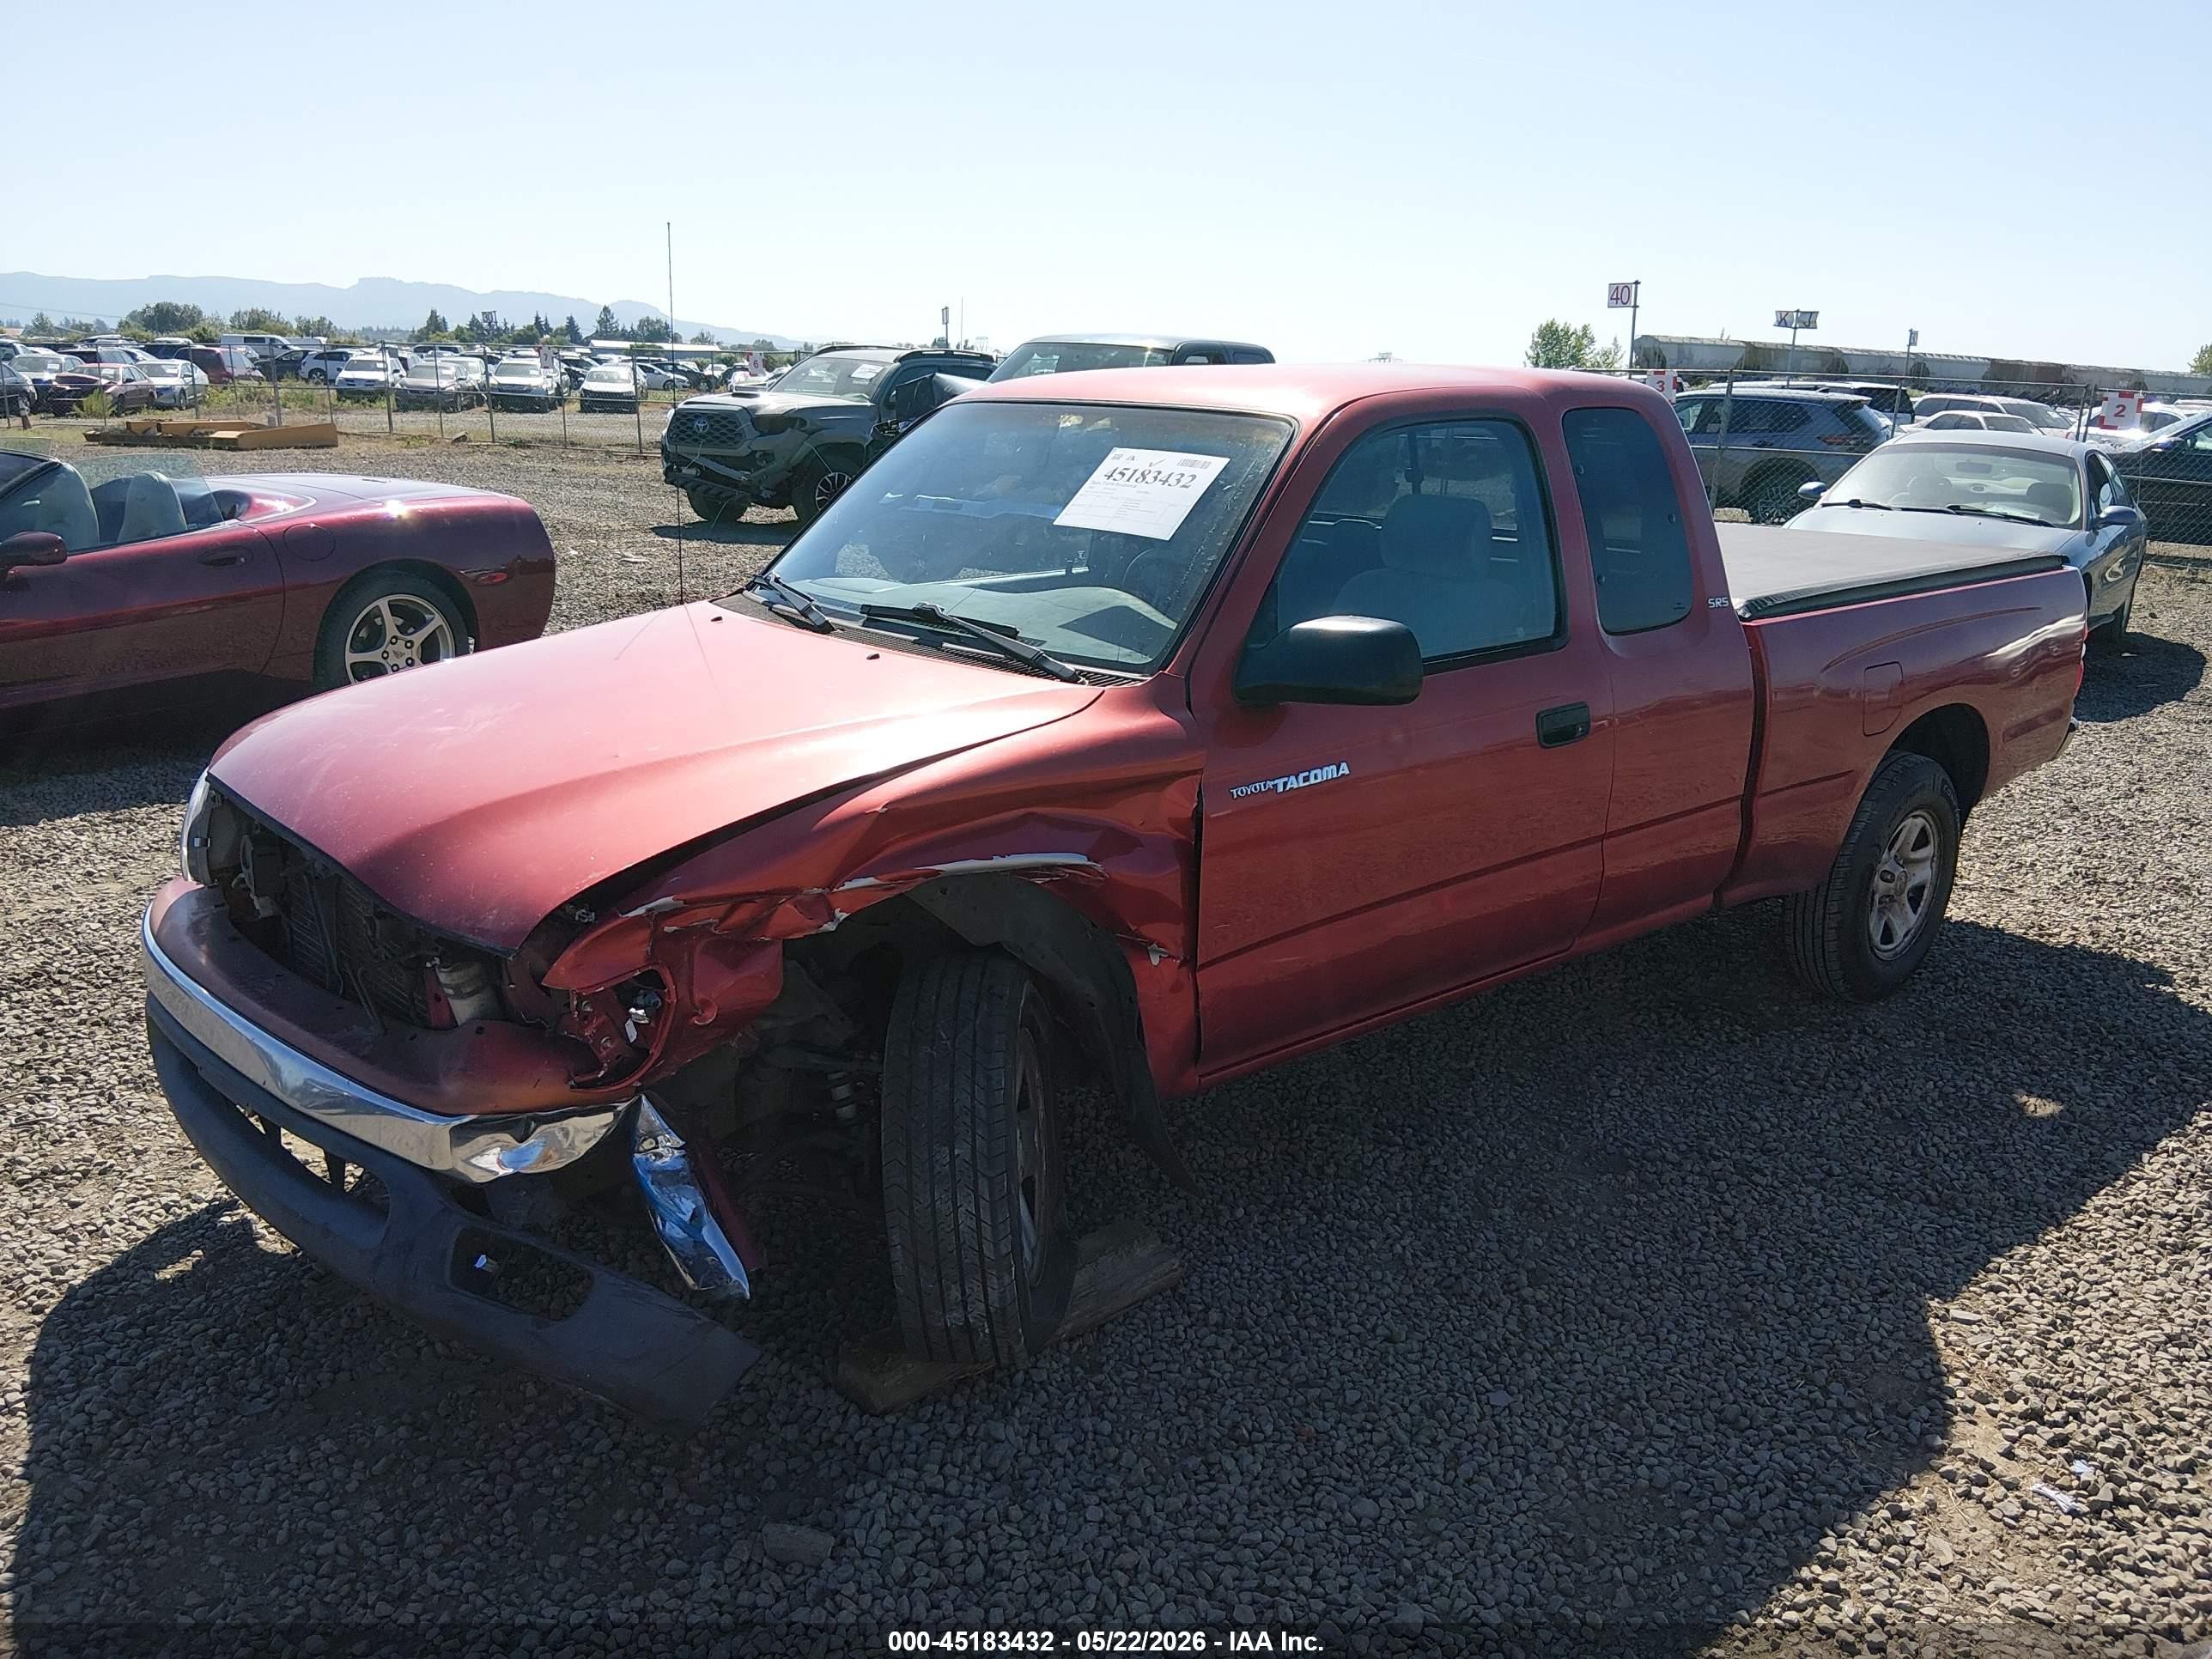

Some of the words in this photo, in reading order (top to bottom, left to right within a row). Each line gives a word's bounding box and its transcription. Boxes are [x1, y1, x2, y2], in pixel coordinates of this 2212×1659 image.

[1610, 285, 1631, 306] 40
[1778, 311, 1790, 327] K
[1803, 312, 1813, 327] J
[753, 360, 759, 369] 6
[1656, 380, 1665, 392] 3
[2113, 404, 2127, 417] 2
[1103, 466, 1197, 489] 45183432
[1230, 781, 1273, 799] TOYOTA
[1273, 762, 1350, 793] TACOMA
